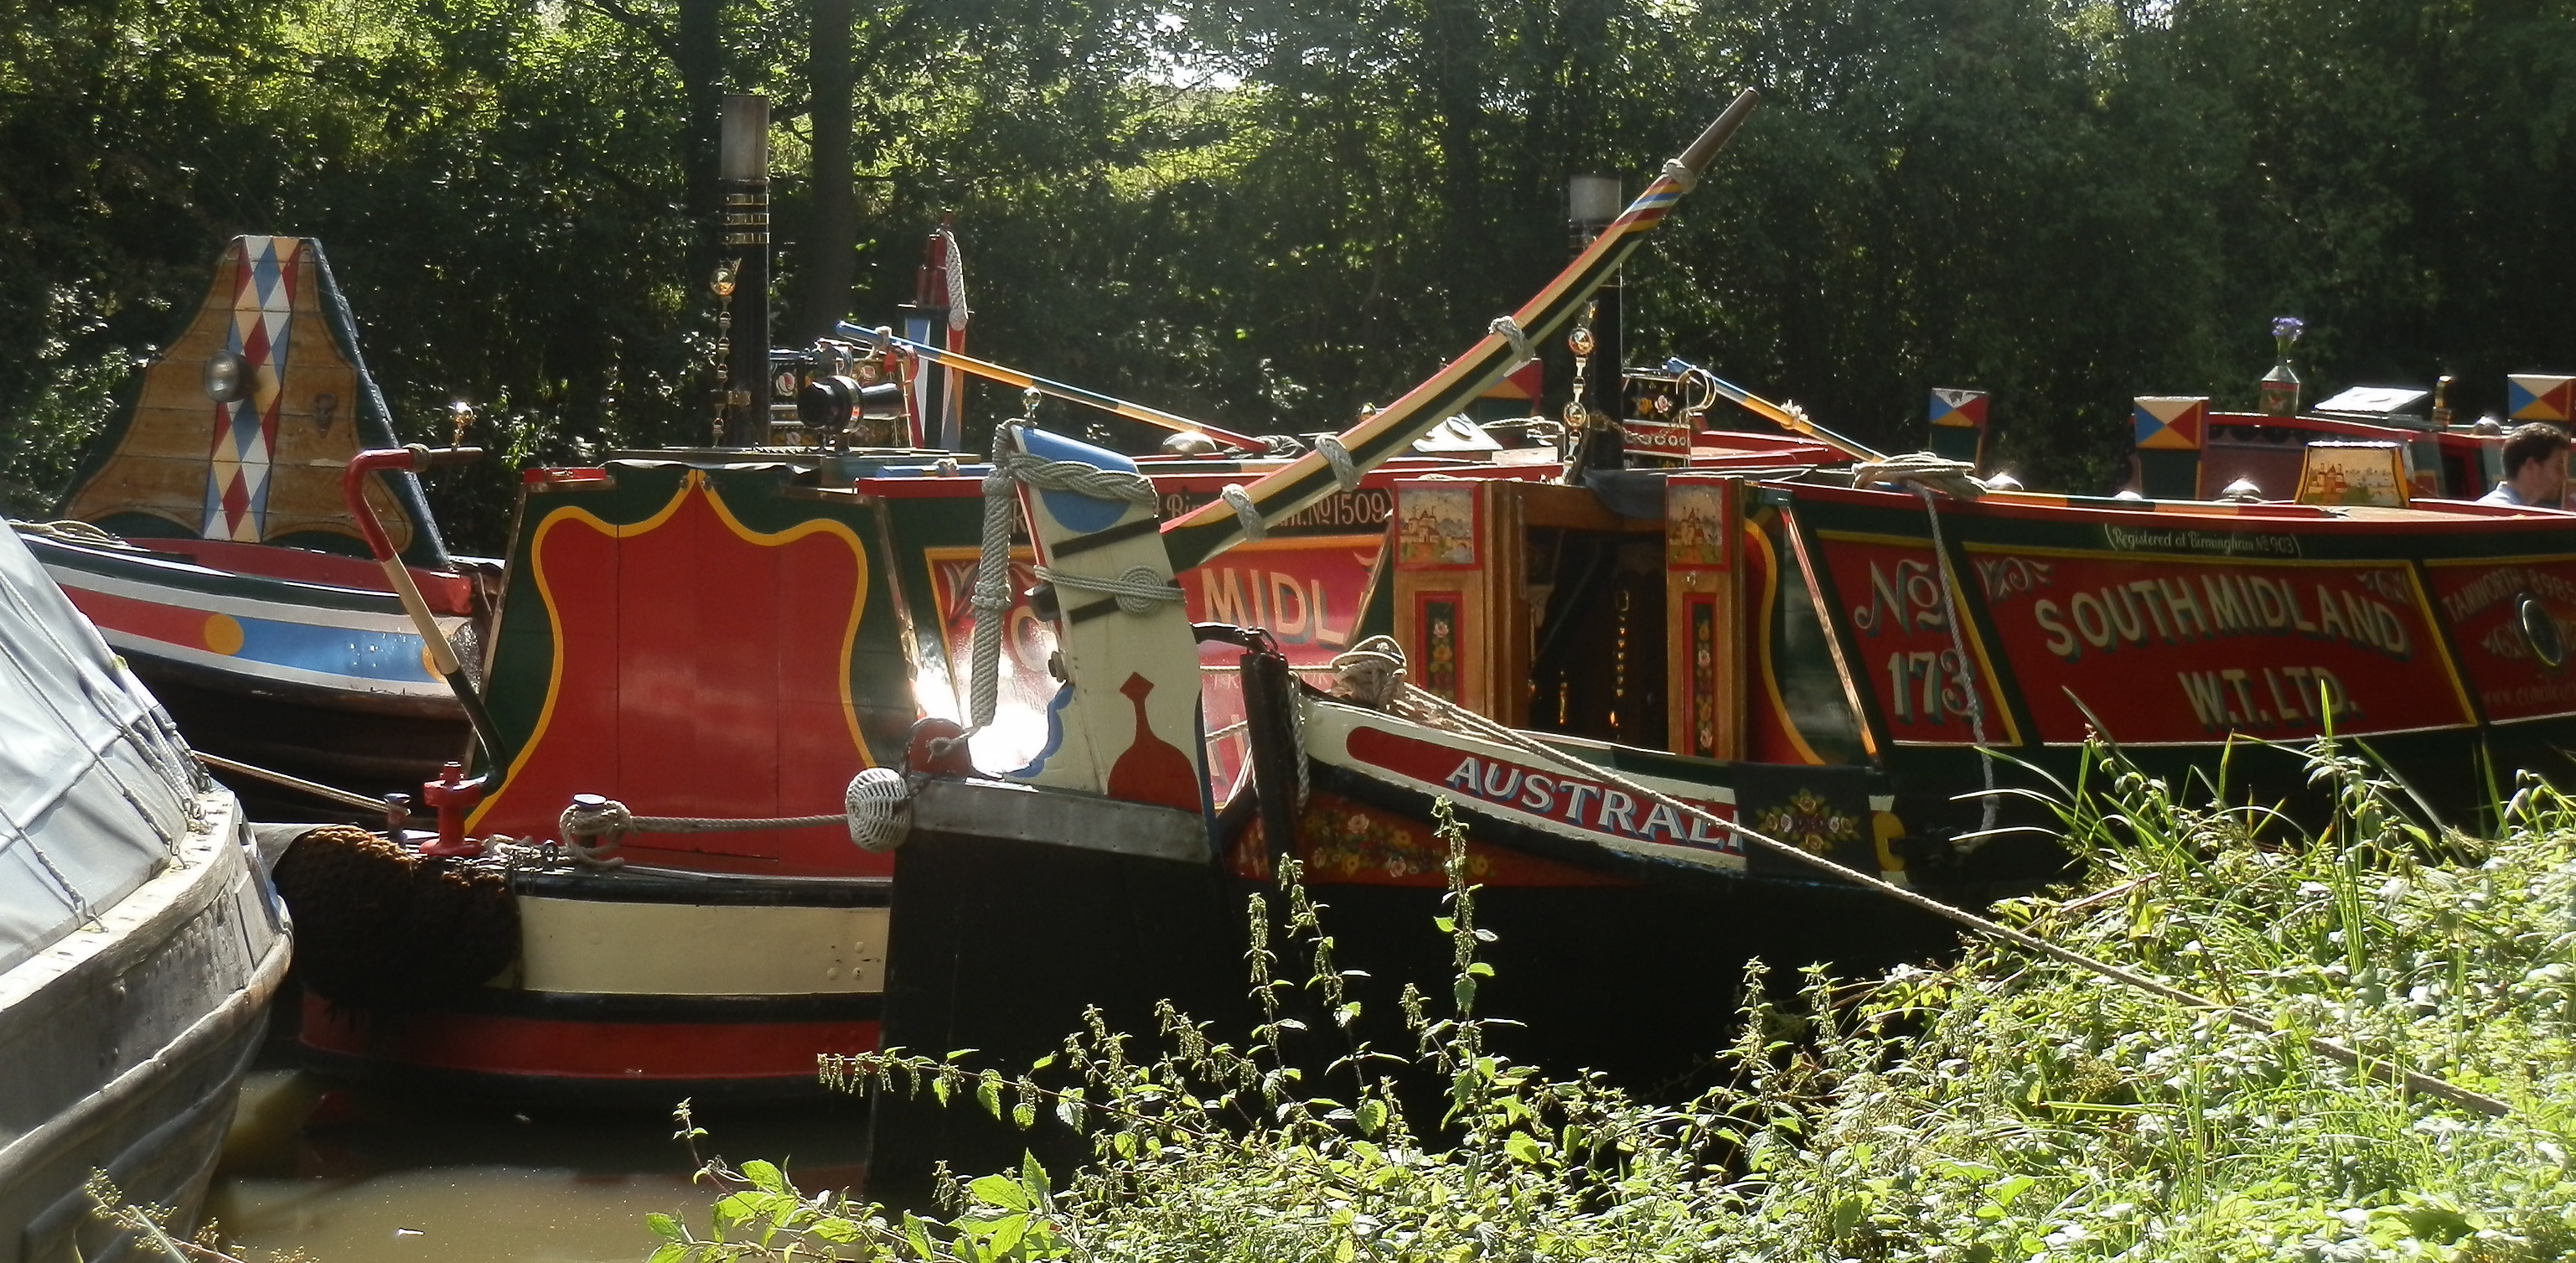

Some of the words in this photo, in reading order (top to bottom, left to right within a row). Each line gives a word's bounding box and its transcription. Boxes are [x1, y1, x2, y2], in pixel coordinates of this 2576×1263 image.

[2175, 532, 2186, 546] at
[2187, 531, 2254, 556] Birmingham
[1200, 567, 1364, 645] MIDL
[2034, 576, 2212, 660] SOUTH
[2201, 574, 2410, 657] MIDLAND
[2441, 567, 2524, 624] TAMWORTH
[1887, 648, 1978, 718] 173
